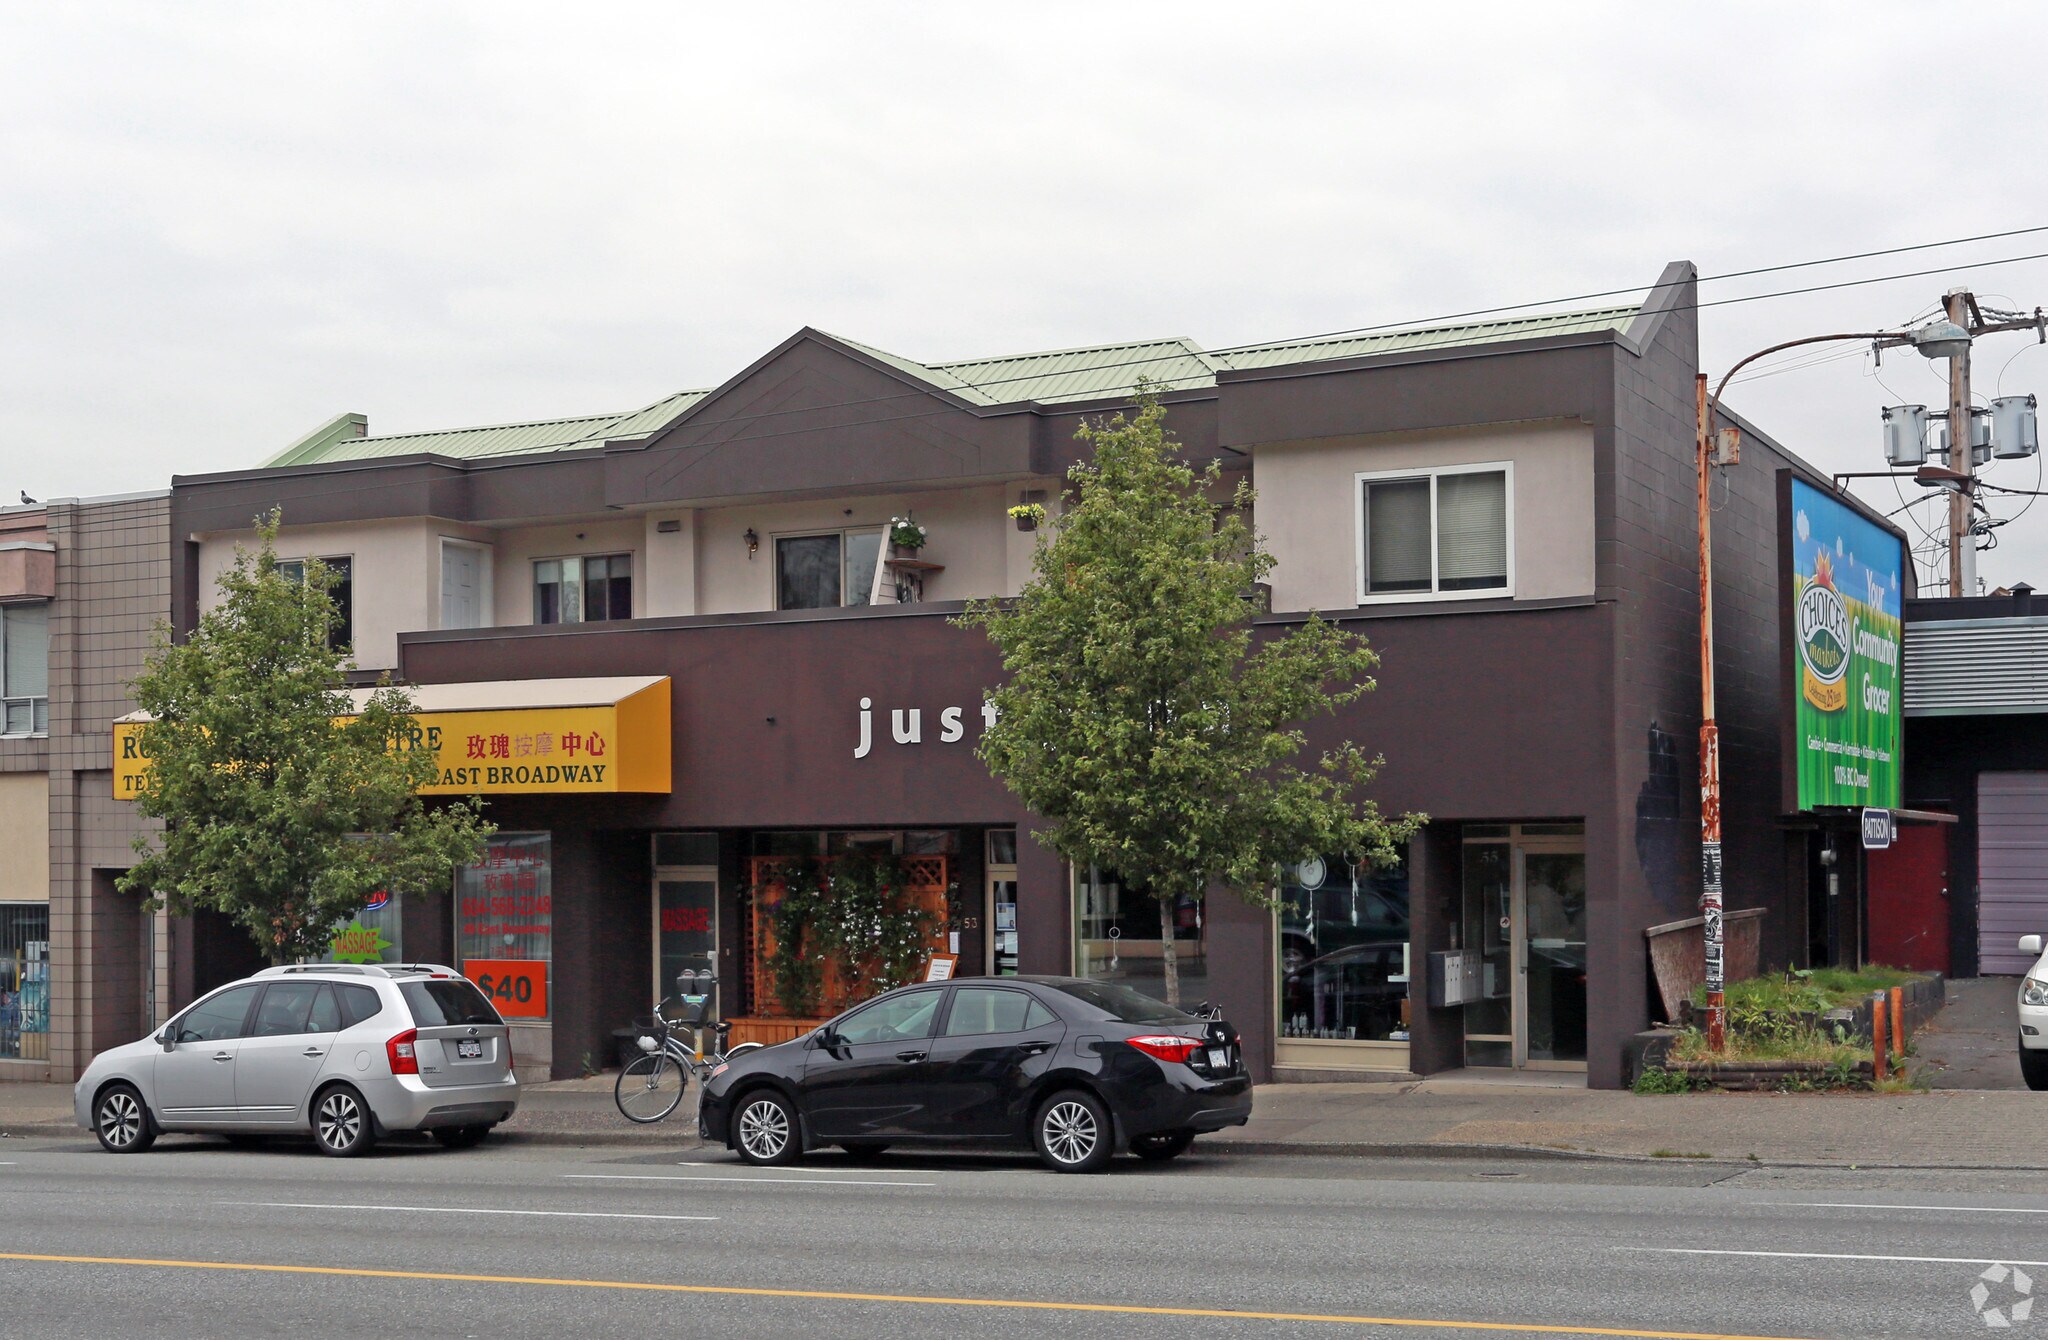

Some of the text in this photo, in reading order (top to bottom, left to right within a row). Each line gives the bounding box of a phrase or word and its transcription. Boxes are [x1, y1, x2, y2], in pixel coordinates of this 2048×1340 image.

[1865, 568, 1884, 612] Your
[1801, 591, 1847, 649] CHOICES
[1808, 634, 1841, 668] markets
[1852, 615, 1898, 679] Community
[1863, 672, 1890, 715] Grocer
[486, 764, 607, 785] BROADWAY
[1834, 765, 1869, 788] 100% BC Owned
[1864, 817, 1889, 839] PATTISON
[502, 923, 550, 937] Broadway
[661, 907, 711, 932] MASSAGE
[964, 917, 978, 929] 53
[335, 931, 378, 954] MASSAGE
[478, 973, 532, 1004] $40
